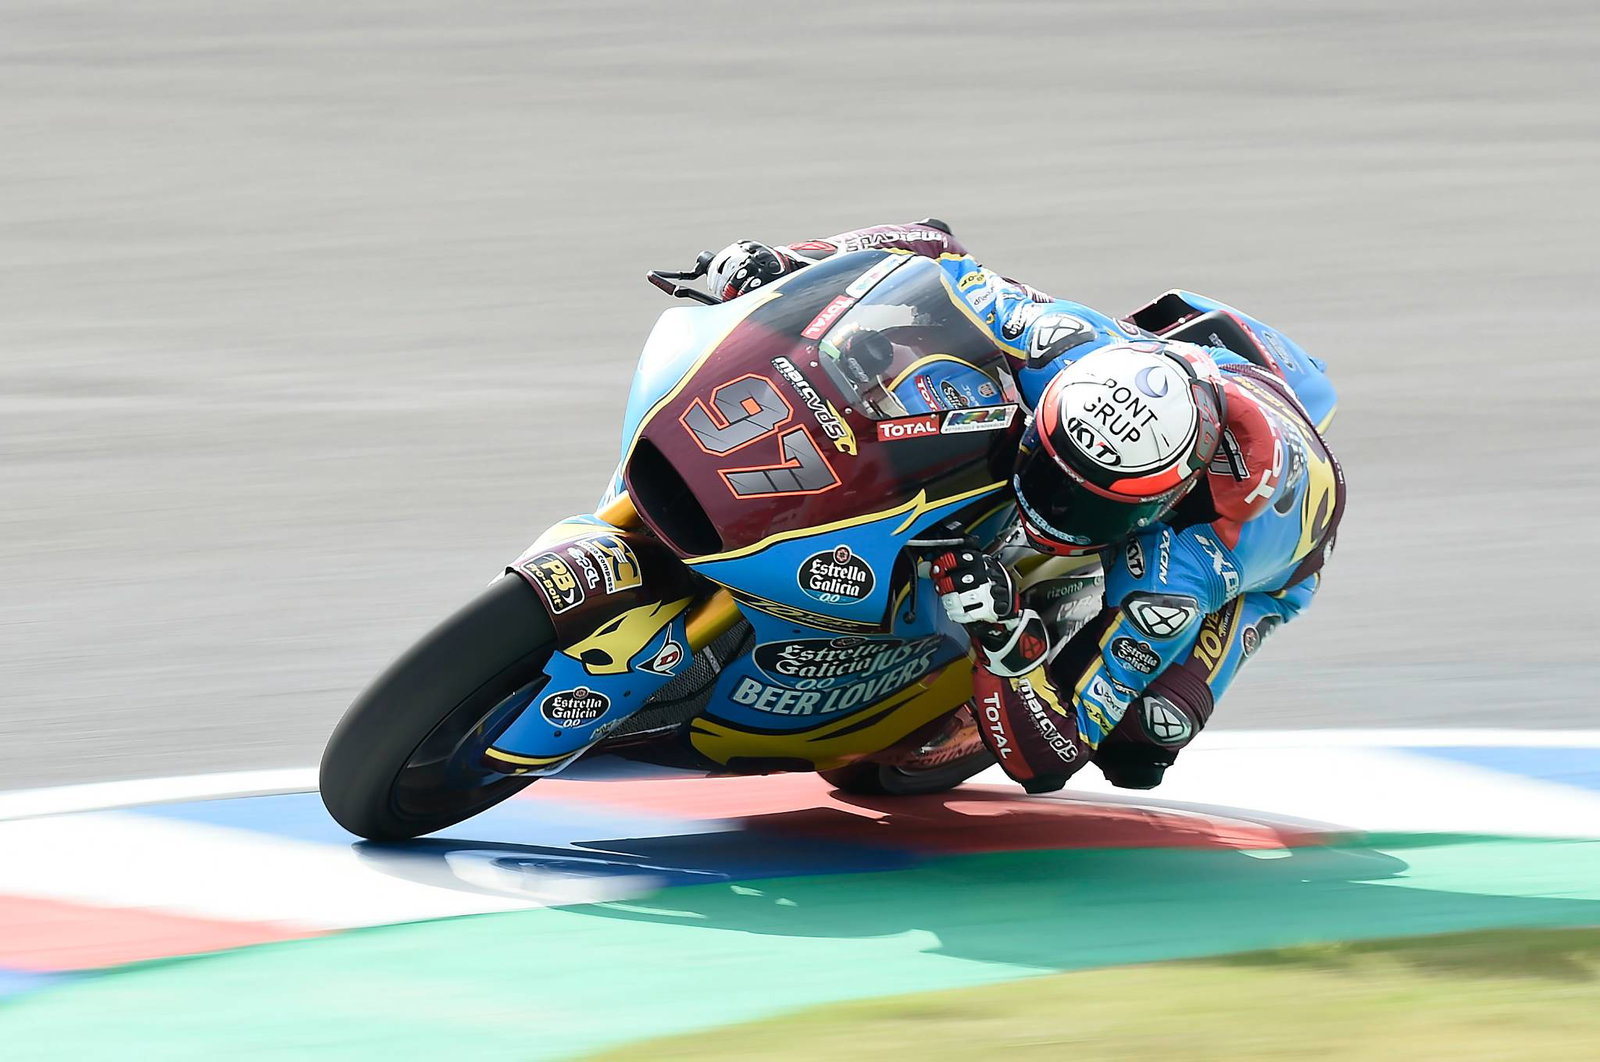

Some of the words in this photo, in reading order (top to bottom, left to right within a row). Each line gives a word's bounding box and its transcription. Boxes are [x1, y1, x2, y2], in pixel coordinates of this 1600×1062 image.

[774, 357, 848, 440] marcvds
[1104, 378, 1158, 427] PONT
[880, 422, 937, 437] TOTAL
[1083, 397, 1141, 443] GRUP
[679, 373, 842, 499] 97
[1069, 418, 1118, 459] KYT
[541, 560, 576, 591] PB
[598, 554, 614, 593] compass
[809, 558, 867, 582] Estrella
[809, 574, 860, 597] Galicia
[1047, 581, 1083, 600] rizoma
[776, 643, 889, 662] Estrella
[1119, 639, 1158, 667] Estrella
[1193, 629, 1222, 672] 10
[733, 678, 820, 715] BEER
[820, 648, 938, 714] LOVERS
[775, 656, 870, 678] Galicia
[552, 696, 602, 708] Estrella
[552, 707, 597, 719] Galicia
[984, 692, 1012, 759] TOTAL
